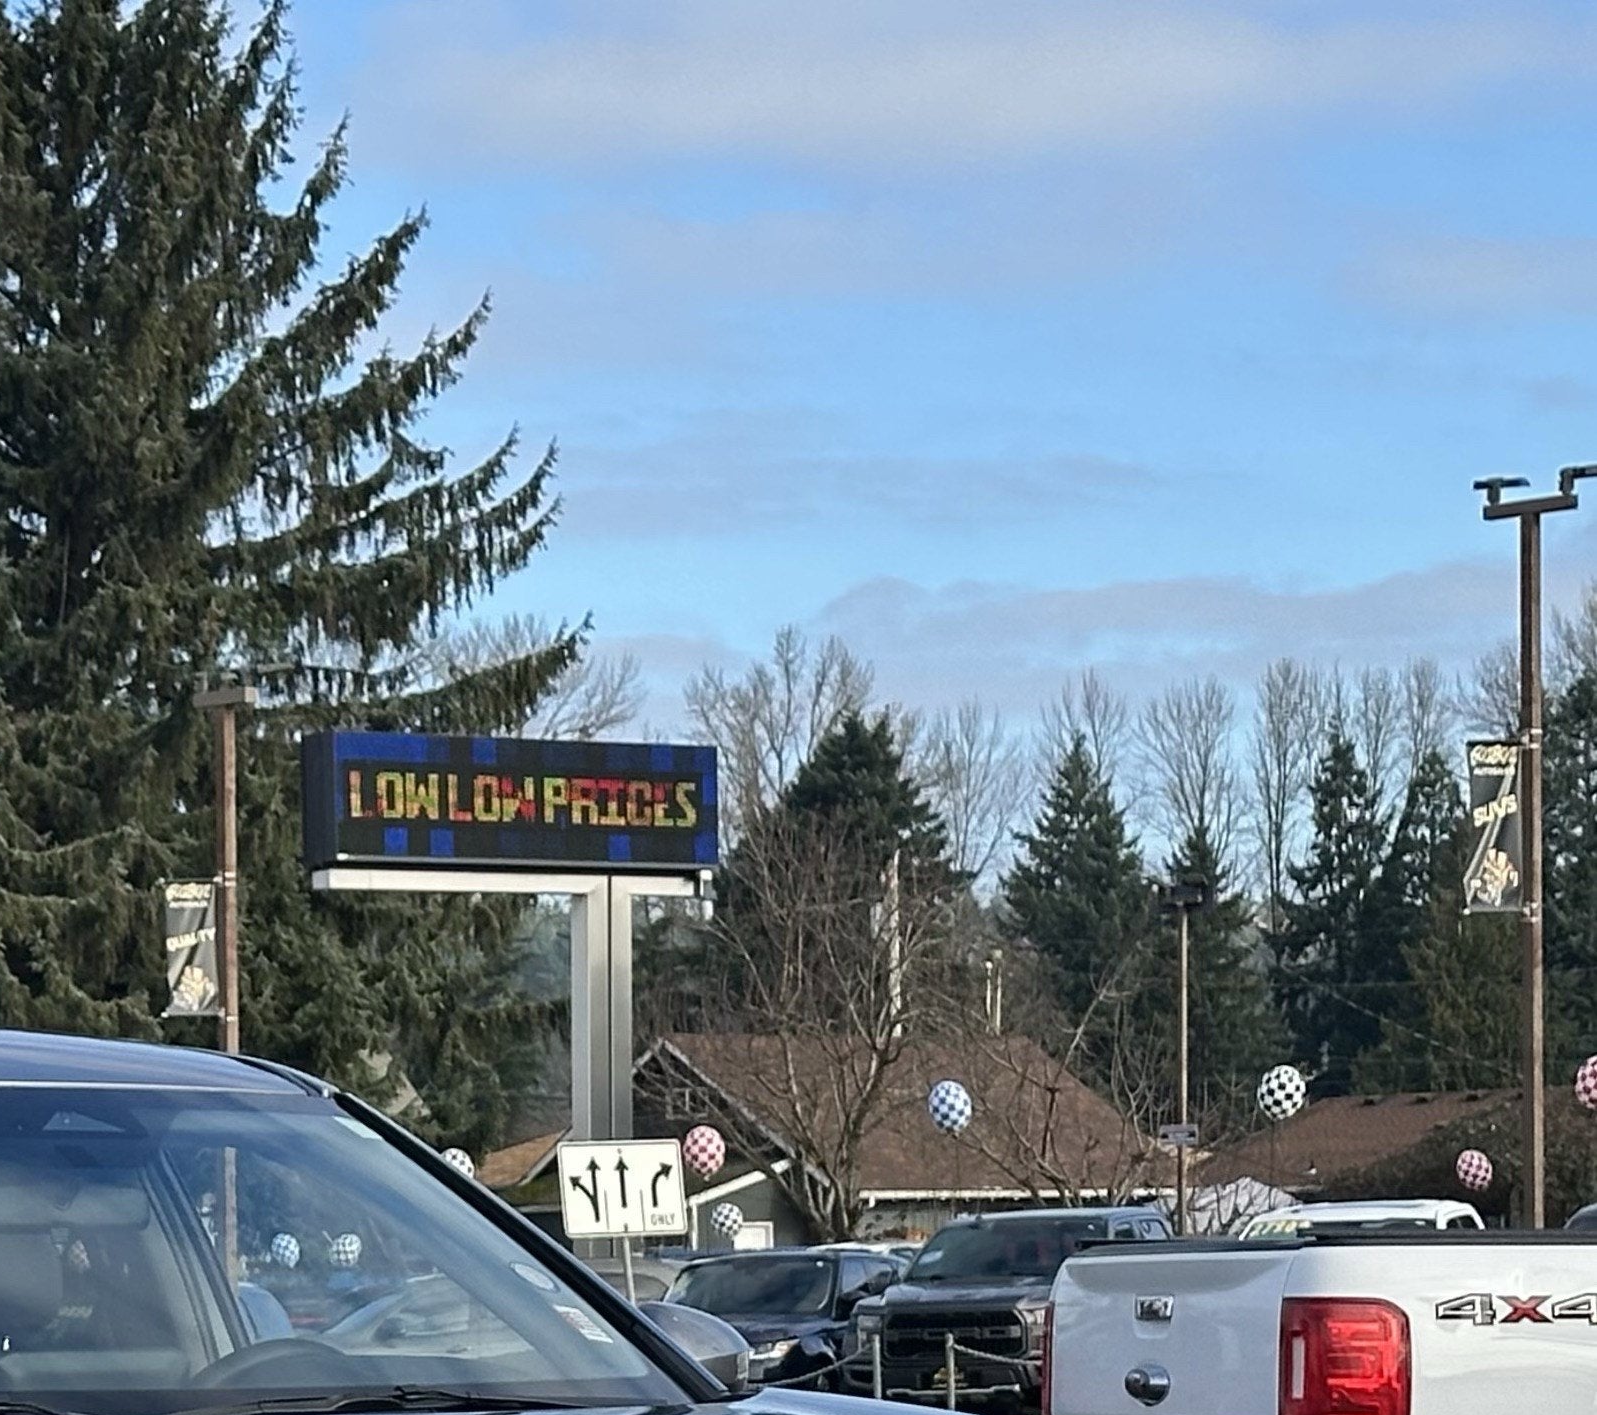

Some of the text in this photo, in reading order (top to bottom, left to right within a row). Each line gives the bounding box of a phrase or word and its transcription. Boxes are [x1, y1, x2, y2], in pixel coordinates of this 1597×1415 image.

[348, 769, 697, 827] LOW LOW PRICES
[650, 1213, 675, 1226] ONLY
